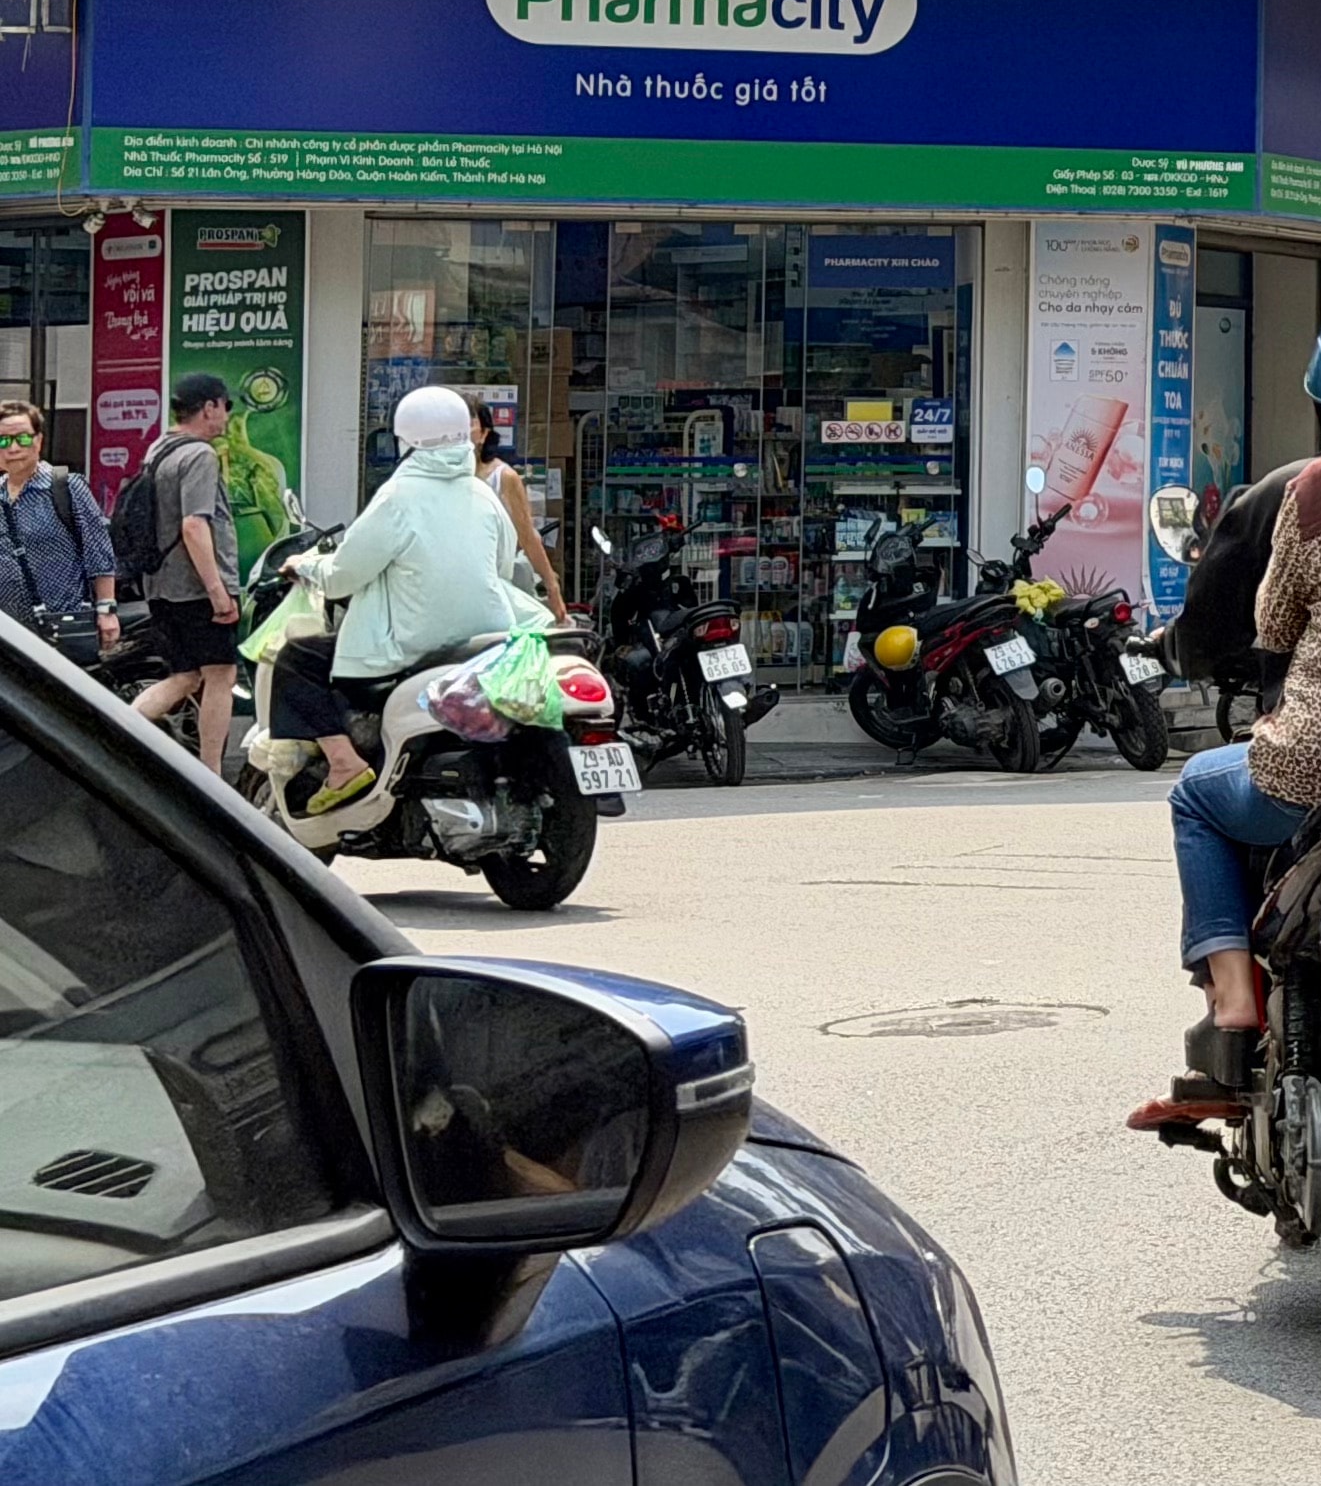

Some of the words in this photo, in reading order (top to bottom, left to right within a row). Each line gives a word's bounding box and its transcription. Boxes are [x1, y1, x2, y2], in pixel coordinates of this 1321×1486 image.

[575, 72, 633, 98] Nhà
[644, 72, 723, 100] thuốc
[735, 75, 779, 106] giá
[790, 74, 828, 104] tốt
[176, 135, 199, 147] kinh
[201, 136, 237, 148] doanh
[245, 137, 263, 148] Chi
[452, 142, 510, 156] Pharmacity
[124, 150, 147, 162] Nhà
[185, 152, 246, 165] Pharmacity
[270, 153, 289, 164] 519
[352, 155, 376, 166] Kinh
[379, 156, 414, 167] Doanh
[187, 166, 199, 178] 21
[824, 257, 890, 268] PHARMACITY
[184, 265, 288, 292] PROSPAN
[267, 290, 287, 304] HO
[1038, 301, 1063, 313] Cho
[1065, 301, 1082, 313] da
[1084, 301, 1115, 317] nhạy
[182, 308, 236, 337] HIỆU
[239, 304, 289, 334] QUẢ
[1163, 390, 1183, 411] TOA
[913, 408, 951, 424] 24/7
